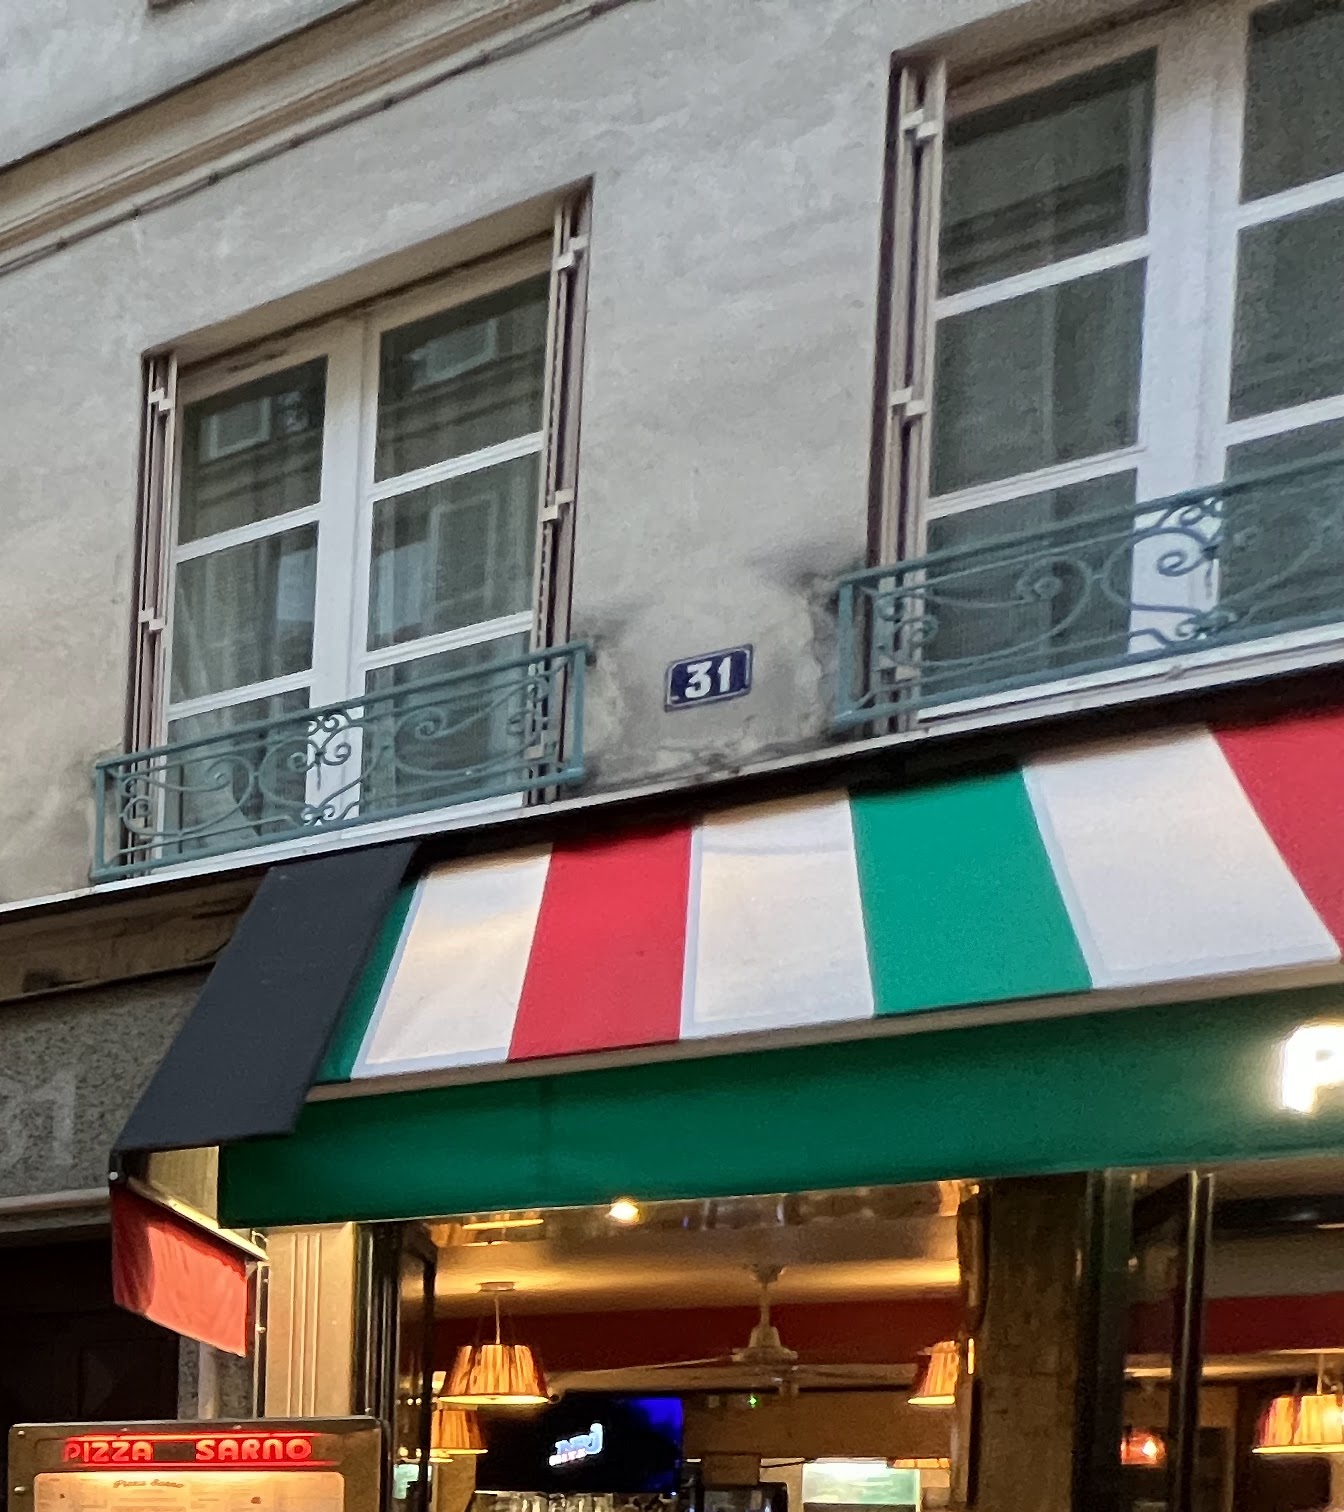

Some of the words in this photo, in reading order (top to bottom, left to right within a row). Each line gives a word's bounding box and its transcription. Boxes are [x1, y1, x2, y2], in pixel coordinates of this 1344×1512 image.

[684, 656, 732, 699] 31
[63, 1441, 154, 1463] PIZZA
[195, 1438, 312, 1461] SARNO
